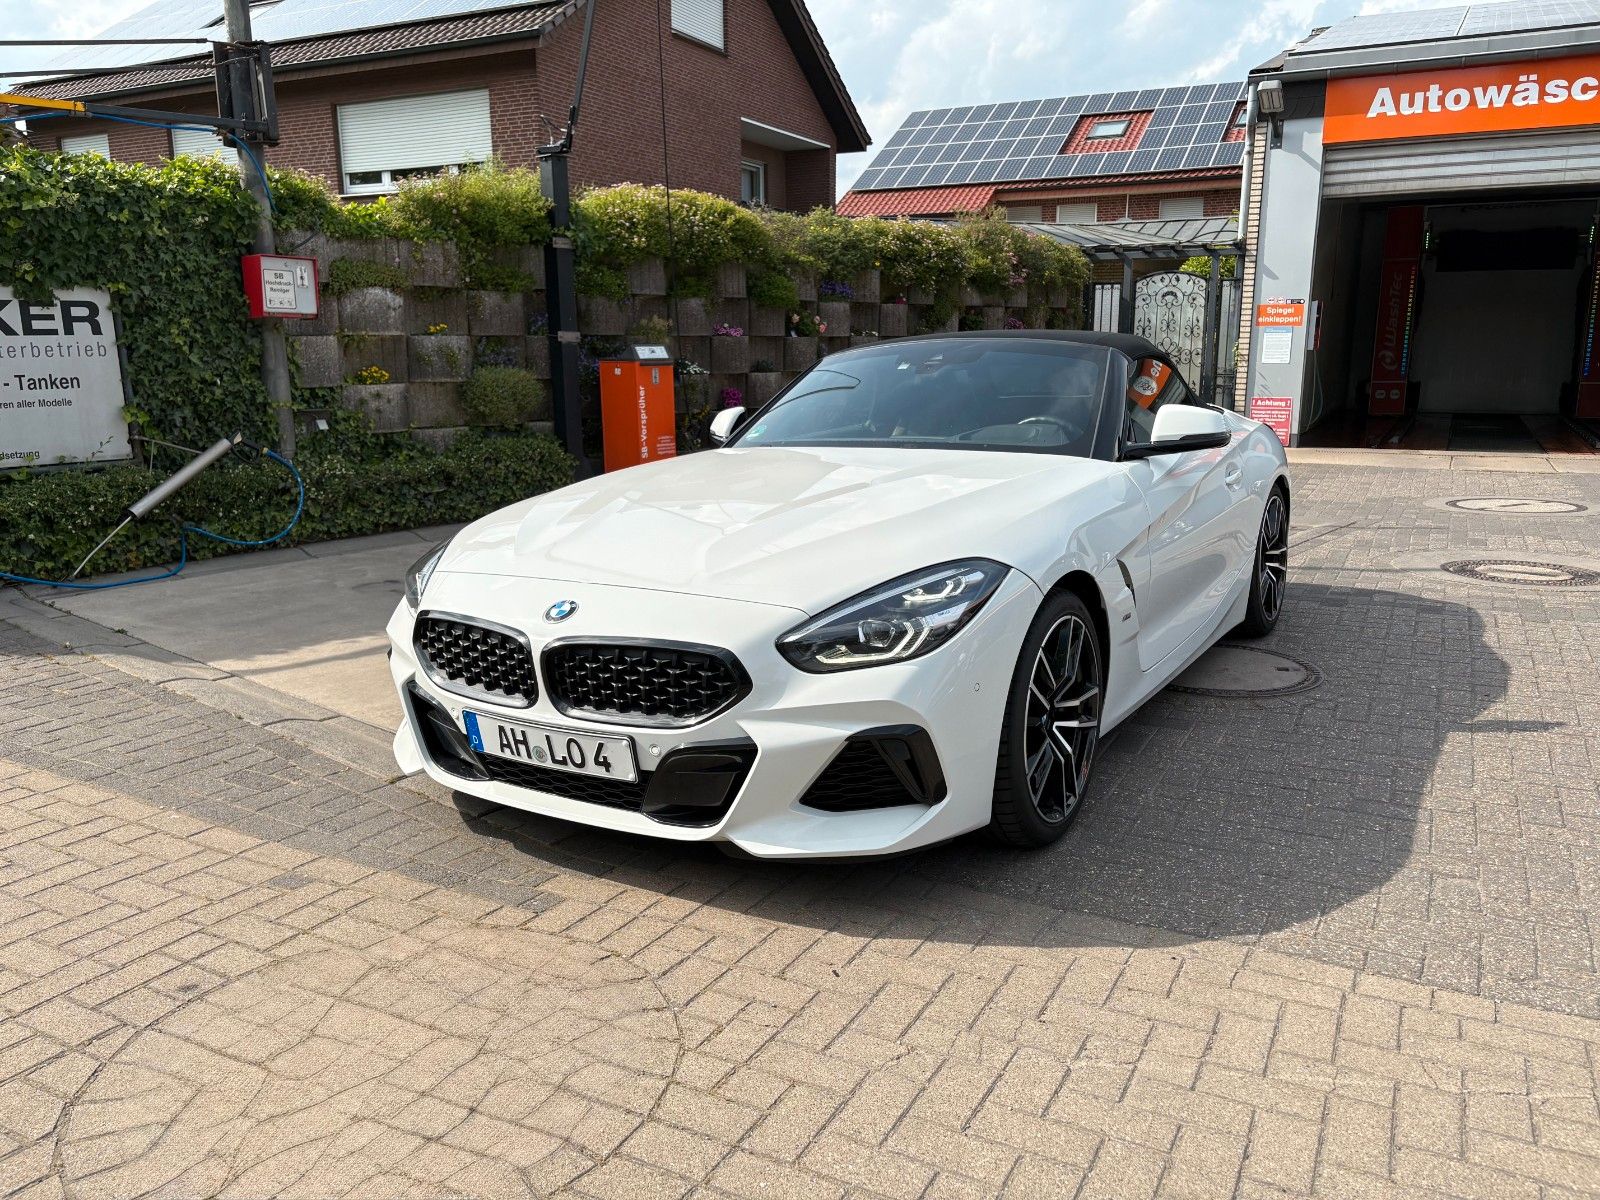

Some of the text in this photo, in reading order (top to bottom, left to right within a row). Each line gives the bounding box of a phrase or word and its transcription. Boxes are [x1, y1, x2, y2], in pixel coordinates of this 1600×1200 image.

[1366, 73, 1600, 118] Autowäsc
[1266, 306, 1295, 315] Spiegel
[1258, 315, 1302, 323] einklappen!
[14, 374, 81, 390] Tanken
[17, 399, 36, 408] aller
[38, 398, 73, 407] Modelle
[1256, 399, 1286, 407] Achtung
[639, 386, 648, 459] SB-Vorsprüher
[473, 735, 479, 744] D
[498, 724, 611, 773] AH LO 4
